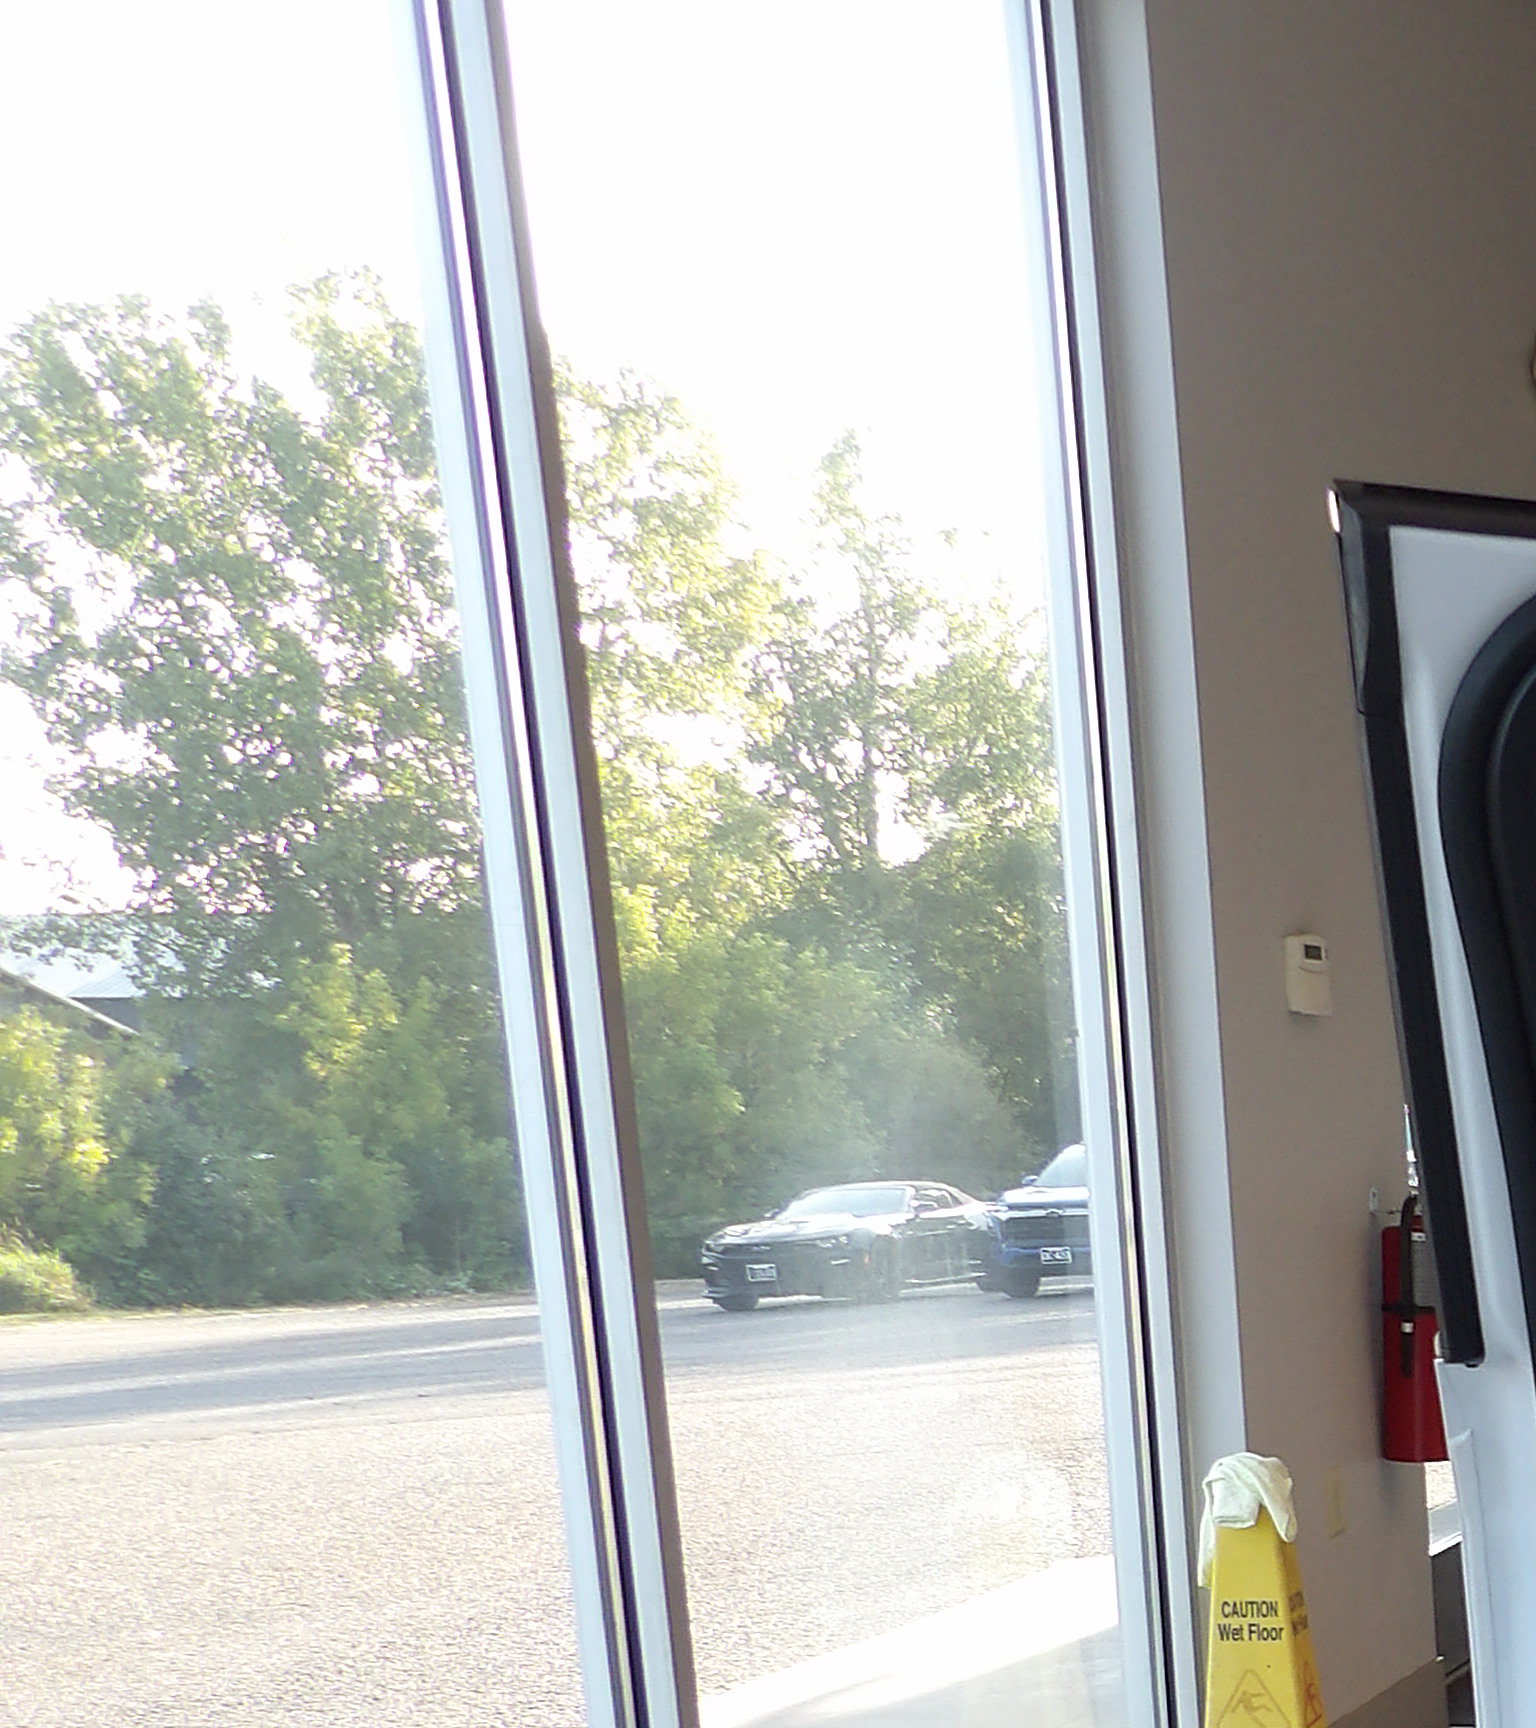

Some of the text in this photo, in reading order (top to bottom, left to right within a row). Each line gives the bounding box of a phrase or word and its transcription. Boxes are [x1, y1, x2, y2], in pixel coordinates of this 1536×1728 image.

[1221, 1600, 1279, 1618] CAUTION
[1217, 1623, 1245, 1641] Wet
[1248, 1623, 1284, 1641] Floor
